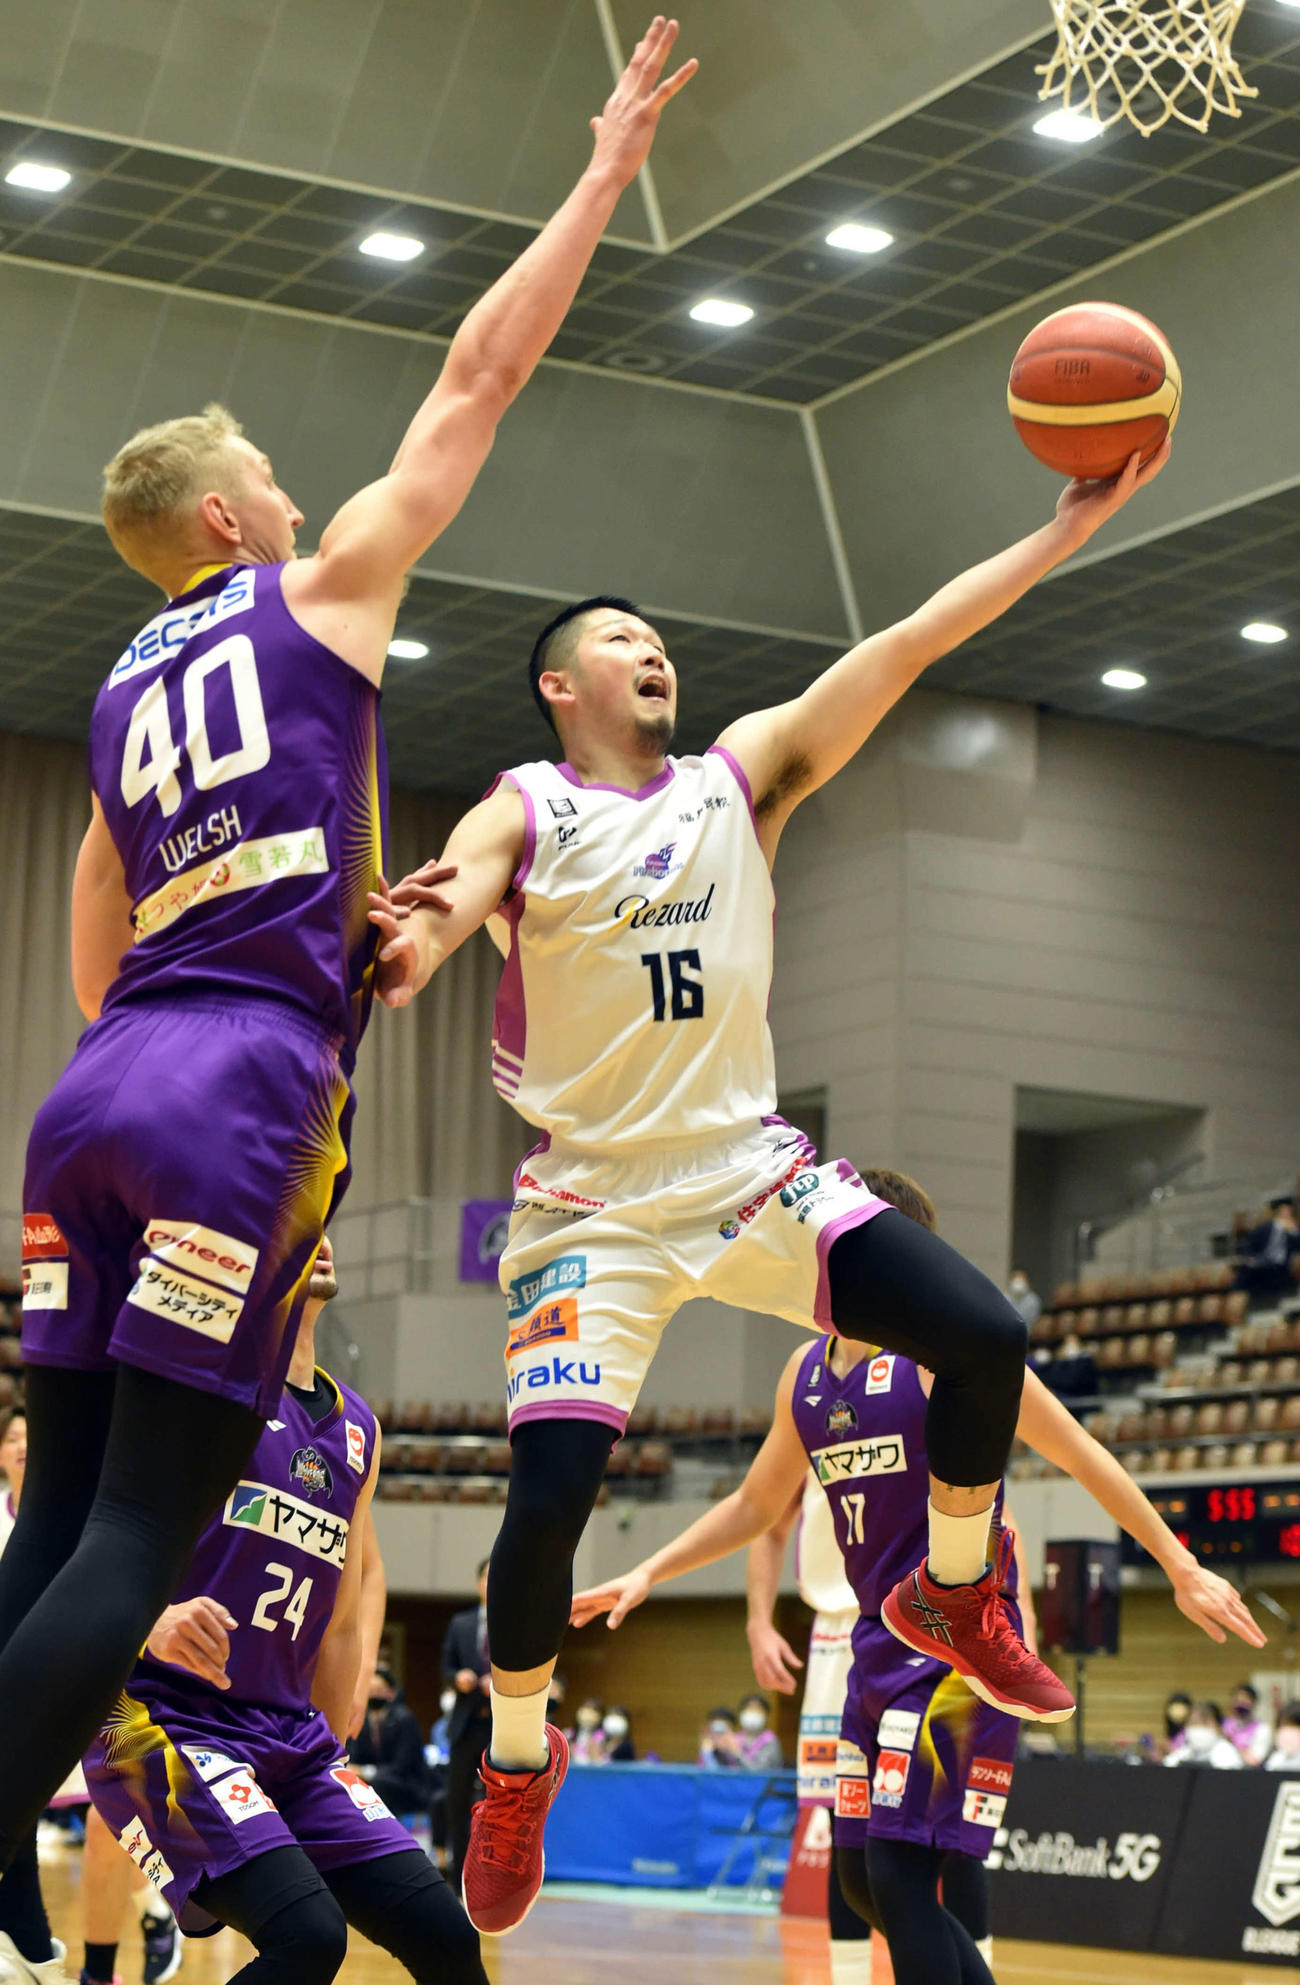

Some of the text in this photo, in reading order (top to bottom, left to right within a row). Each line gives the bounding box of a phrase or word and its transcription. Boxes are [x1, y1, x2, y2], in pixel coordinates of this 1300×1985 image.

[1055, 359, 1090, 375] FIBA
[114, 580, 248, 676] DECYS
[120, 633, 271, 818] 40
[159, 804, 243, 872] WELSH
[614, 882, 716, 930] Rezard
[640, 948, 704, 1022] 16
[148, 1229, 251, 1273] Pneer
[146, 1270, 238, 1320] ダイバーシティ
[157, 1295, 213, 1323] メディア
[824, 1443, 901, 1474] ヤマザワ
[840, 1492, 866, 1546] 17
[251, 1561, 314, 1642] 24
[1003, 1827, 1161, 1882] SoftBank 5G
